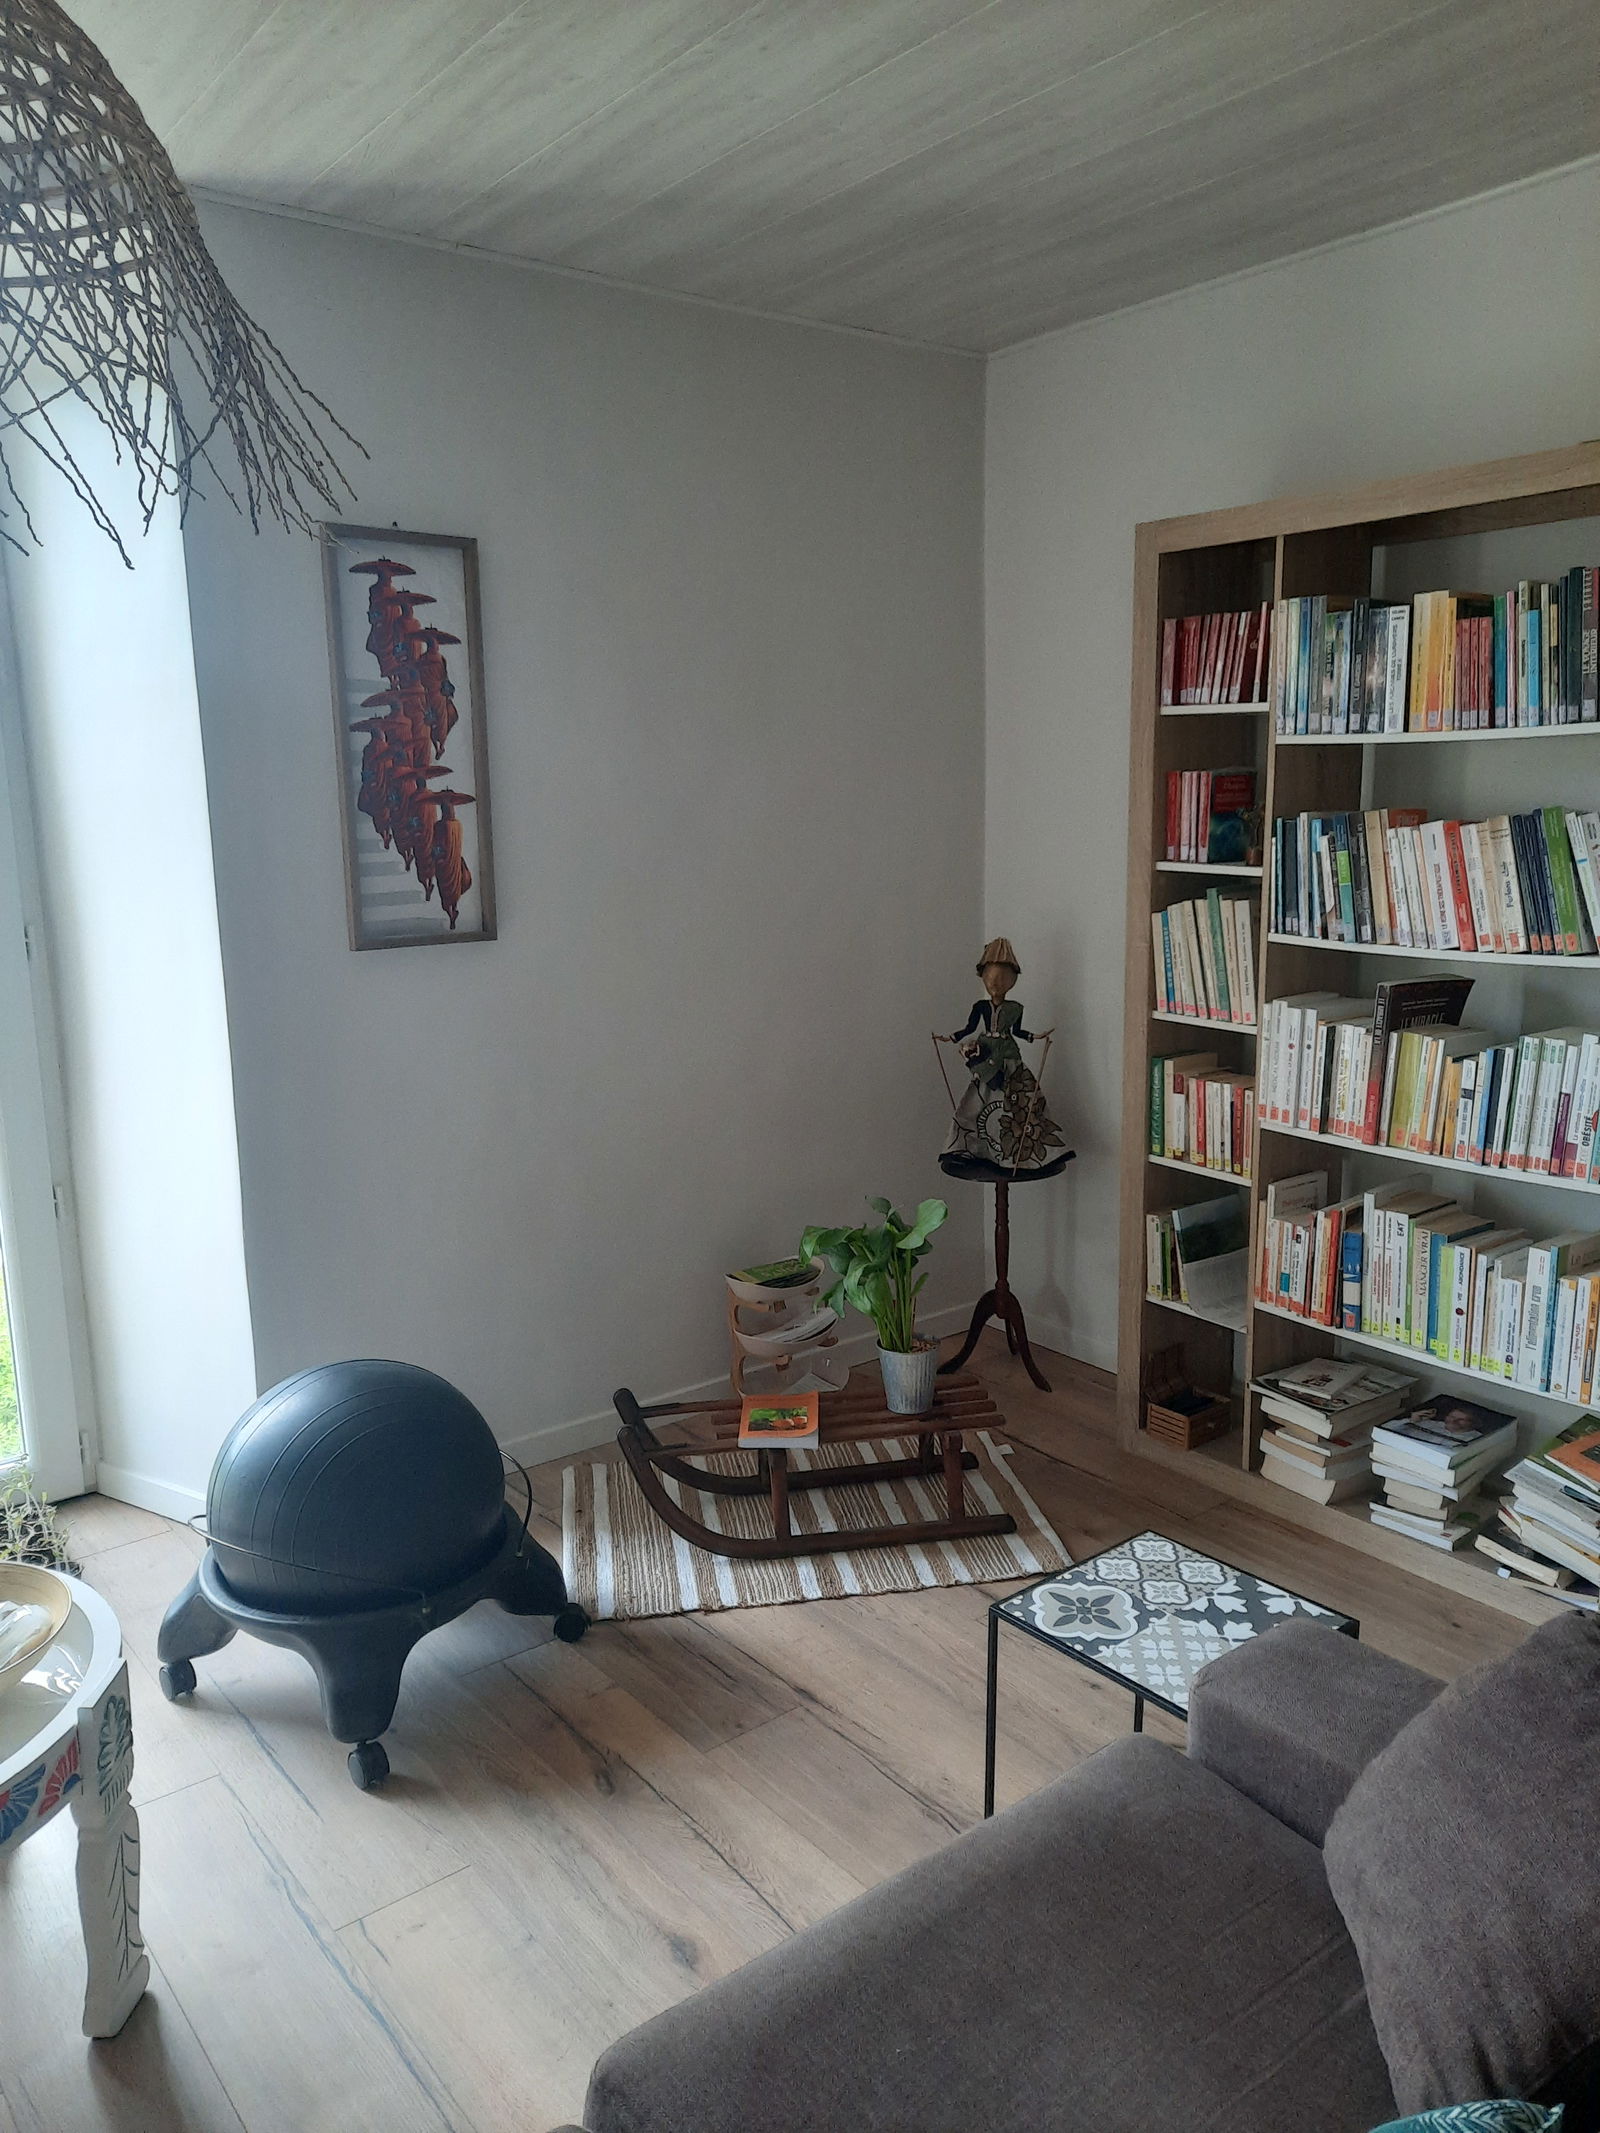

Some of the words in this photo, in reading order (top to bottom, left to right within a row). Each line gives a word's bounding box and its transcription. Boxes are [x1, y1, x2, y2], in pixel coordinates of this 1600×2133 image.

[1582, 1116, 1592, 1147] OBÉSITÉ
[1396, 1220, 1405, 1237] EAT
[1421, 1231, 1429, 1254] VRAI
[1419, 1256, 1428, 1297] MANGER
